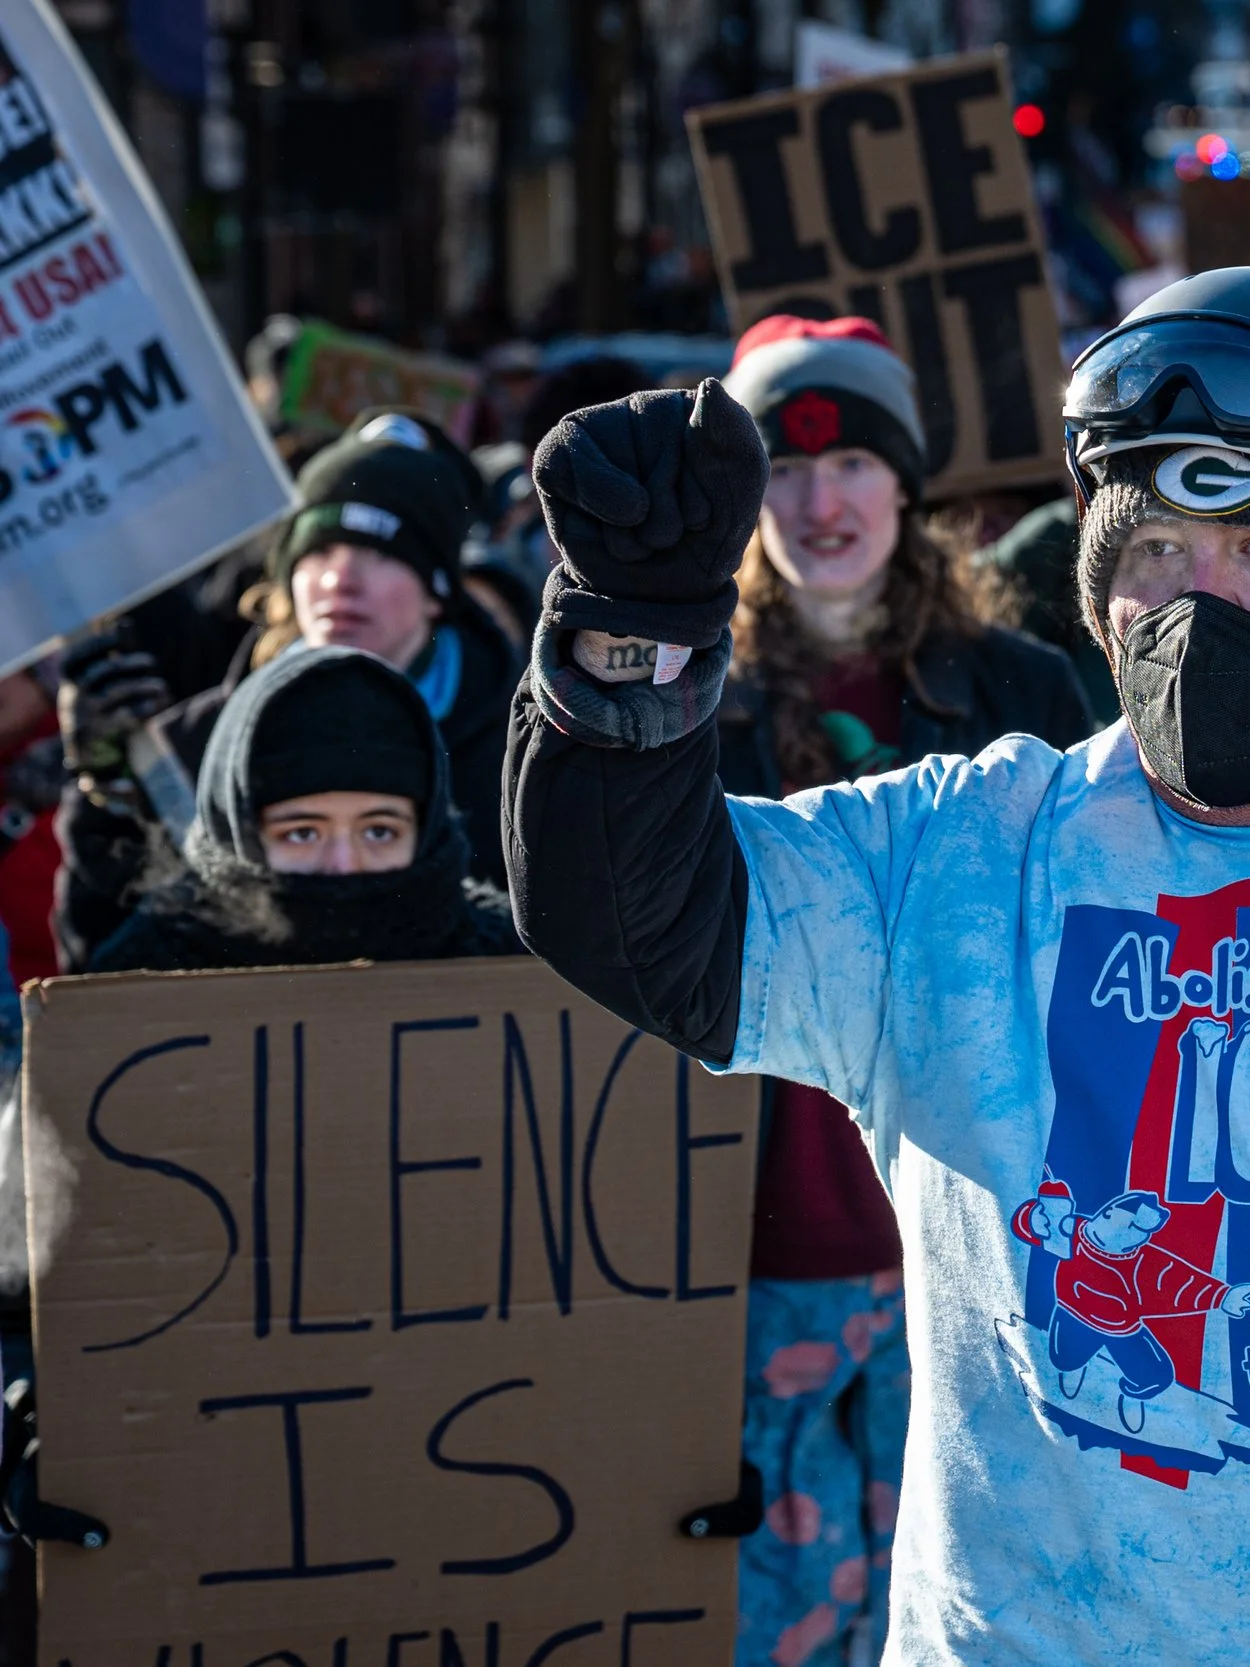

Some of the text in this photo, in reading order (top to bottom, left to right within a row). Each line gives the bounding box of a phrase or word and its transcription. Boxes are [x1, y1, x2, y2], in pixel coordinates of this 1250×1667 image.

[12, 232, 124, 321] USA!
[701, 69, 1030, 290] ICE
[757, 253, 1044, 478] UT
[82, 1009, 742, 1352] SILENCE
[199, 1379, 575, 1586] IS
